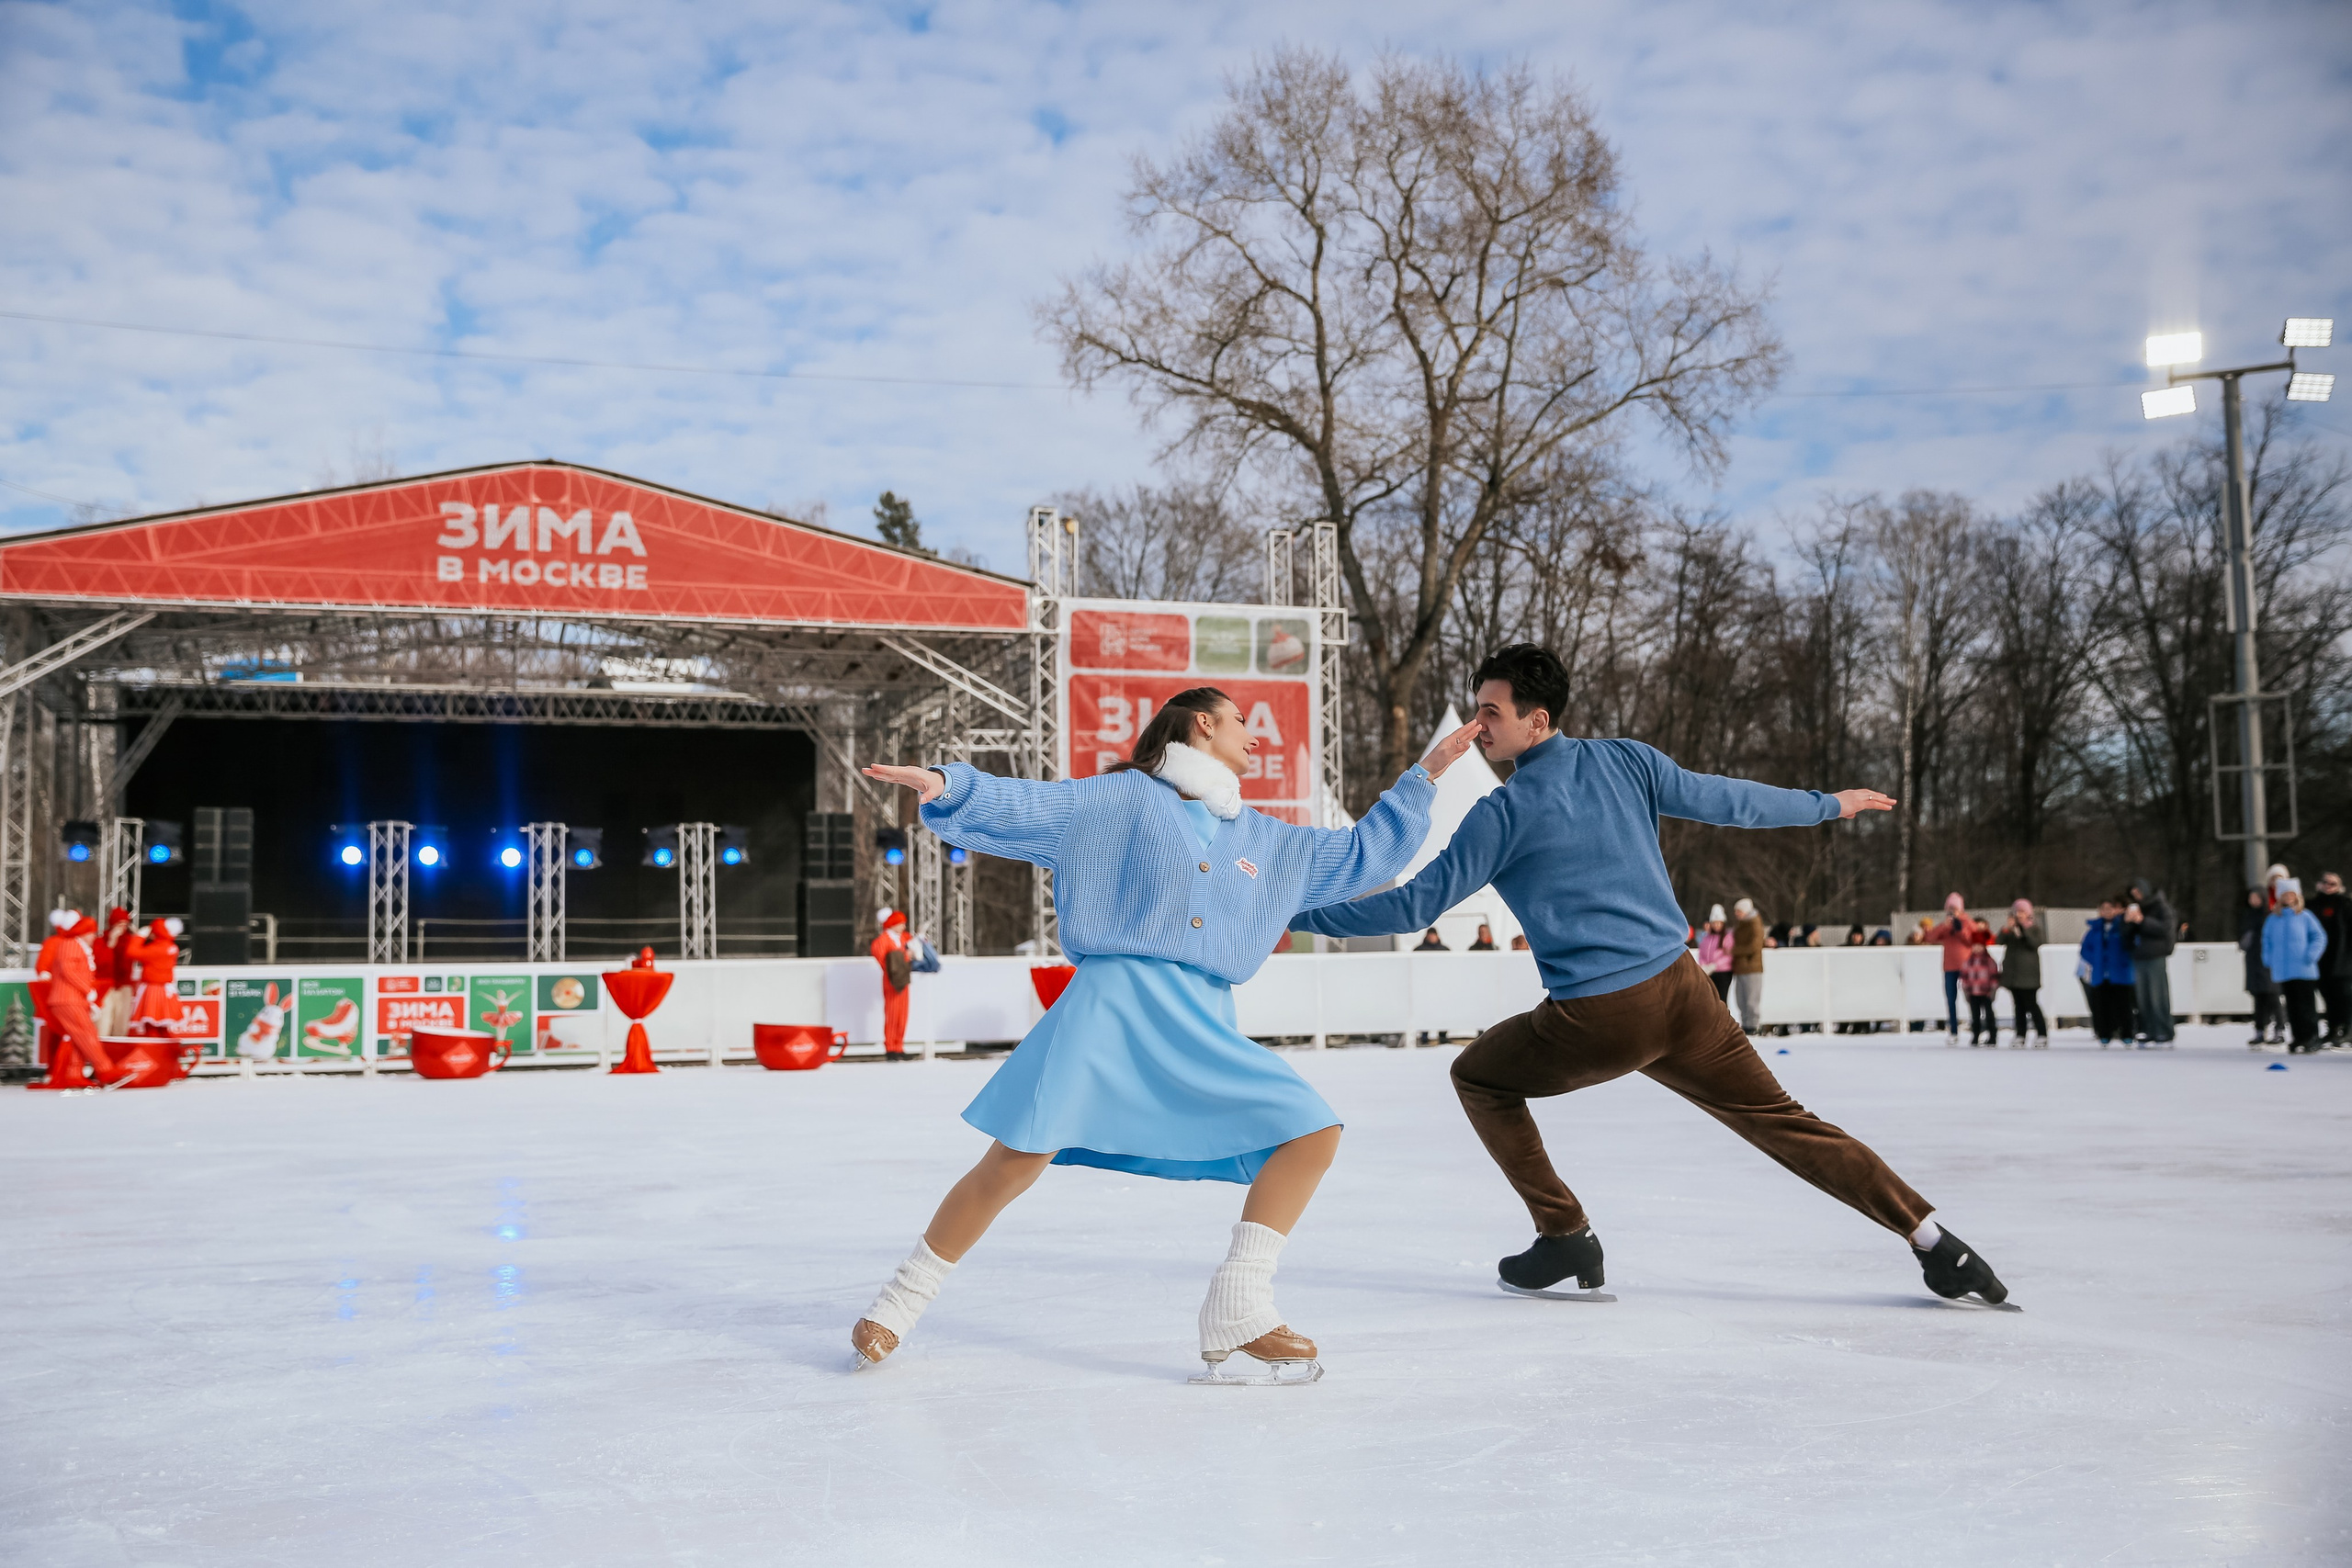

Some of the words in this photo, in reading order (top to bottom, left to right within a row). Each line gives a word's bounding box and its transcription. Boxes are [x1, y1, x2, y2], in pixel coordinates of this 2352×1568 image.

[436, 501, 648, 557] ЗИМА
[437, 555, 464, 581] В
[478, 558, 649, 590] МОСКВЕ
[1096, 696, 1283, 746] ЗА
[387, 1000, 455, 1019] ЗИМА
